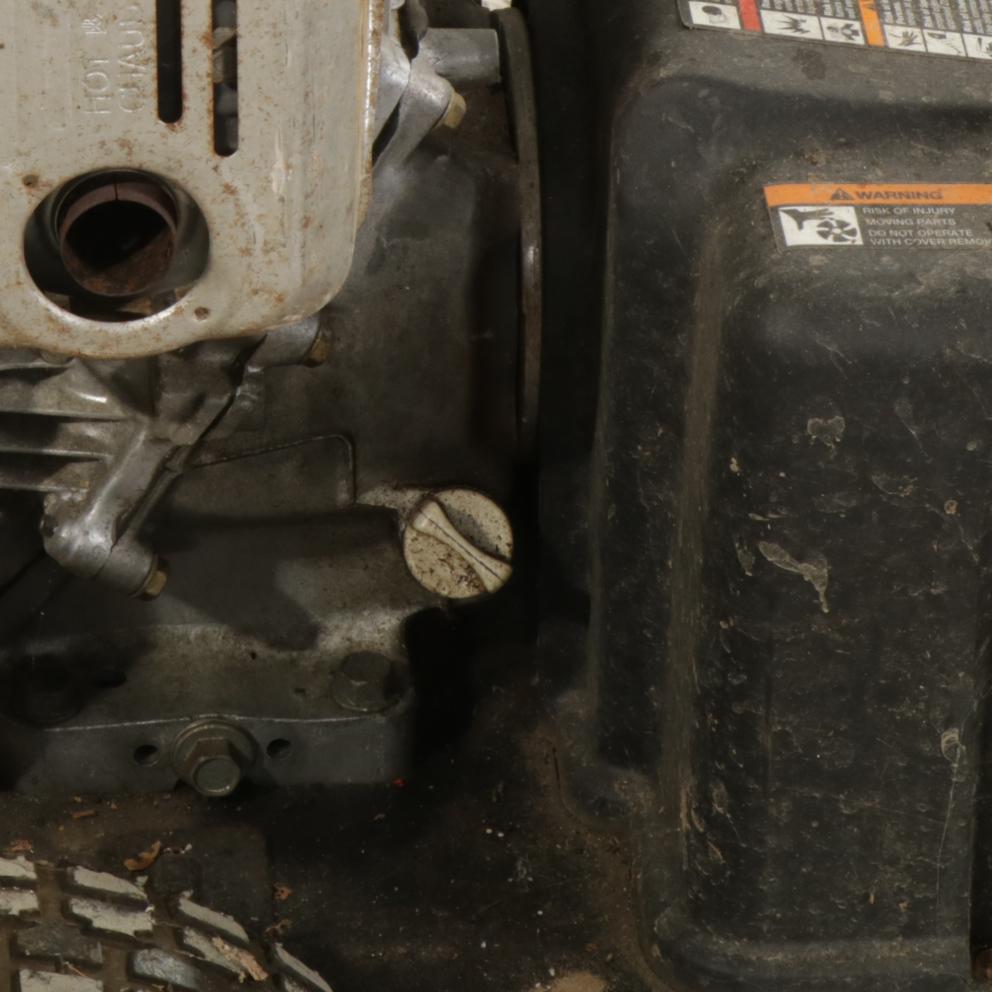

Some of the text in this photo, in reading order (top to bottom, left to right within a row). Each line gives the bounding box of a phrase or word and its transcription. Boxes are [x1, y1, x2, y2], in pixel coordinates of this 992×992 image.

[856, 191, 944, 200] WARNING
[862, 207, 892, 215] RISK
[912, 207, 956, 215] INJURY
[865, 218, 957, 226] MOVING PARTS
[868, 229, 973, 237] DO NOT OPERATE
[871, 238, 901, 246] WITH
[904, 238, 945, 246] COVER
